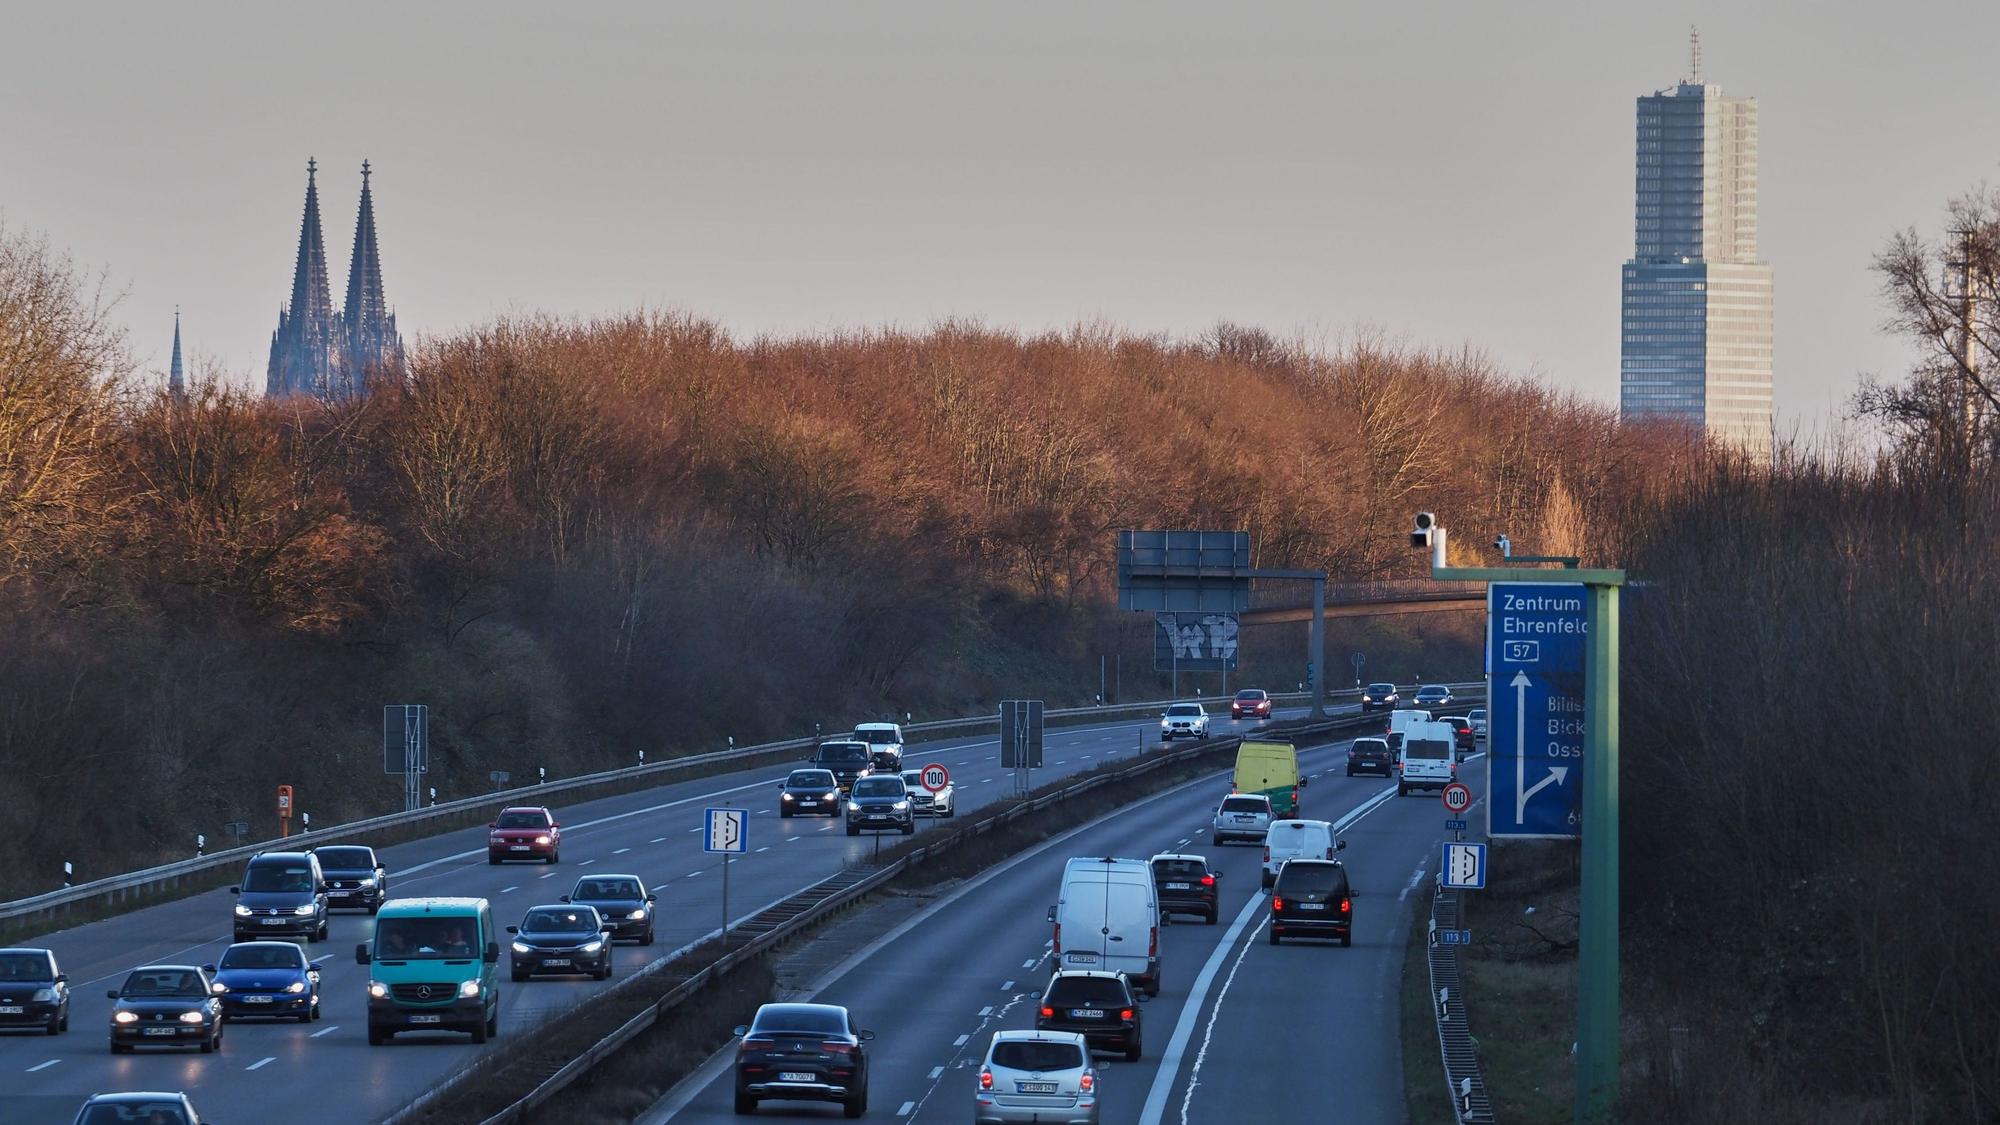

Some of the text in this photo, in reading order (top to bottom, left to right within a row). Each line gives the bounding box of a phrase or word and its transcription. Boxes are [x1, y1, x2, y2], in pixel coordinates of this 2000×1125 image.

[1504, 594, 1581, 611] Zentrum
[1513, 644, 1530, 658] 57
[1548, 741, 1584, 757] Oss
[926, 772, 943, 784] 100
[1448, 791, 1465, 804] 100
